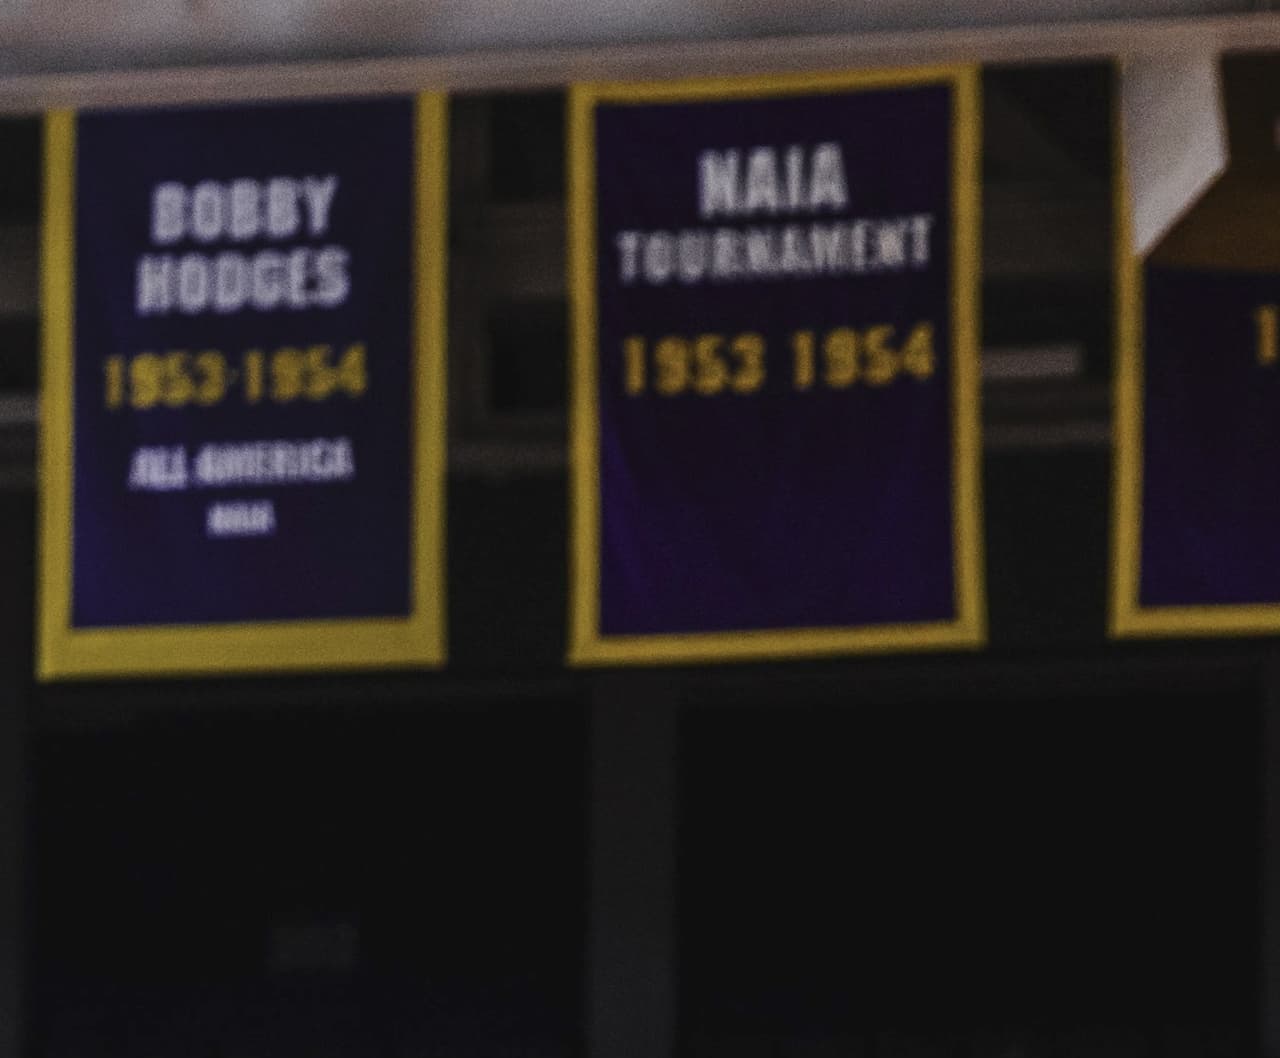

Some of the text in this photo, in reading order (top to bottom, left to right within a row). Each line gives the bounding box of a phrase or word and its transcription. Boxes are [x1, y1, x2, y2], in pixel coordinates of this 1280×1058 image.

[151, 174, 337, 244] BOBBY
[698, 142, 849, 219] NAIA
[136, 245, 350, 315] HODGES
[616, 213, 934, 286] TOURNAMENT
